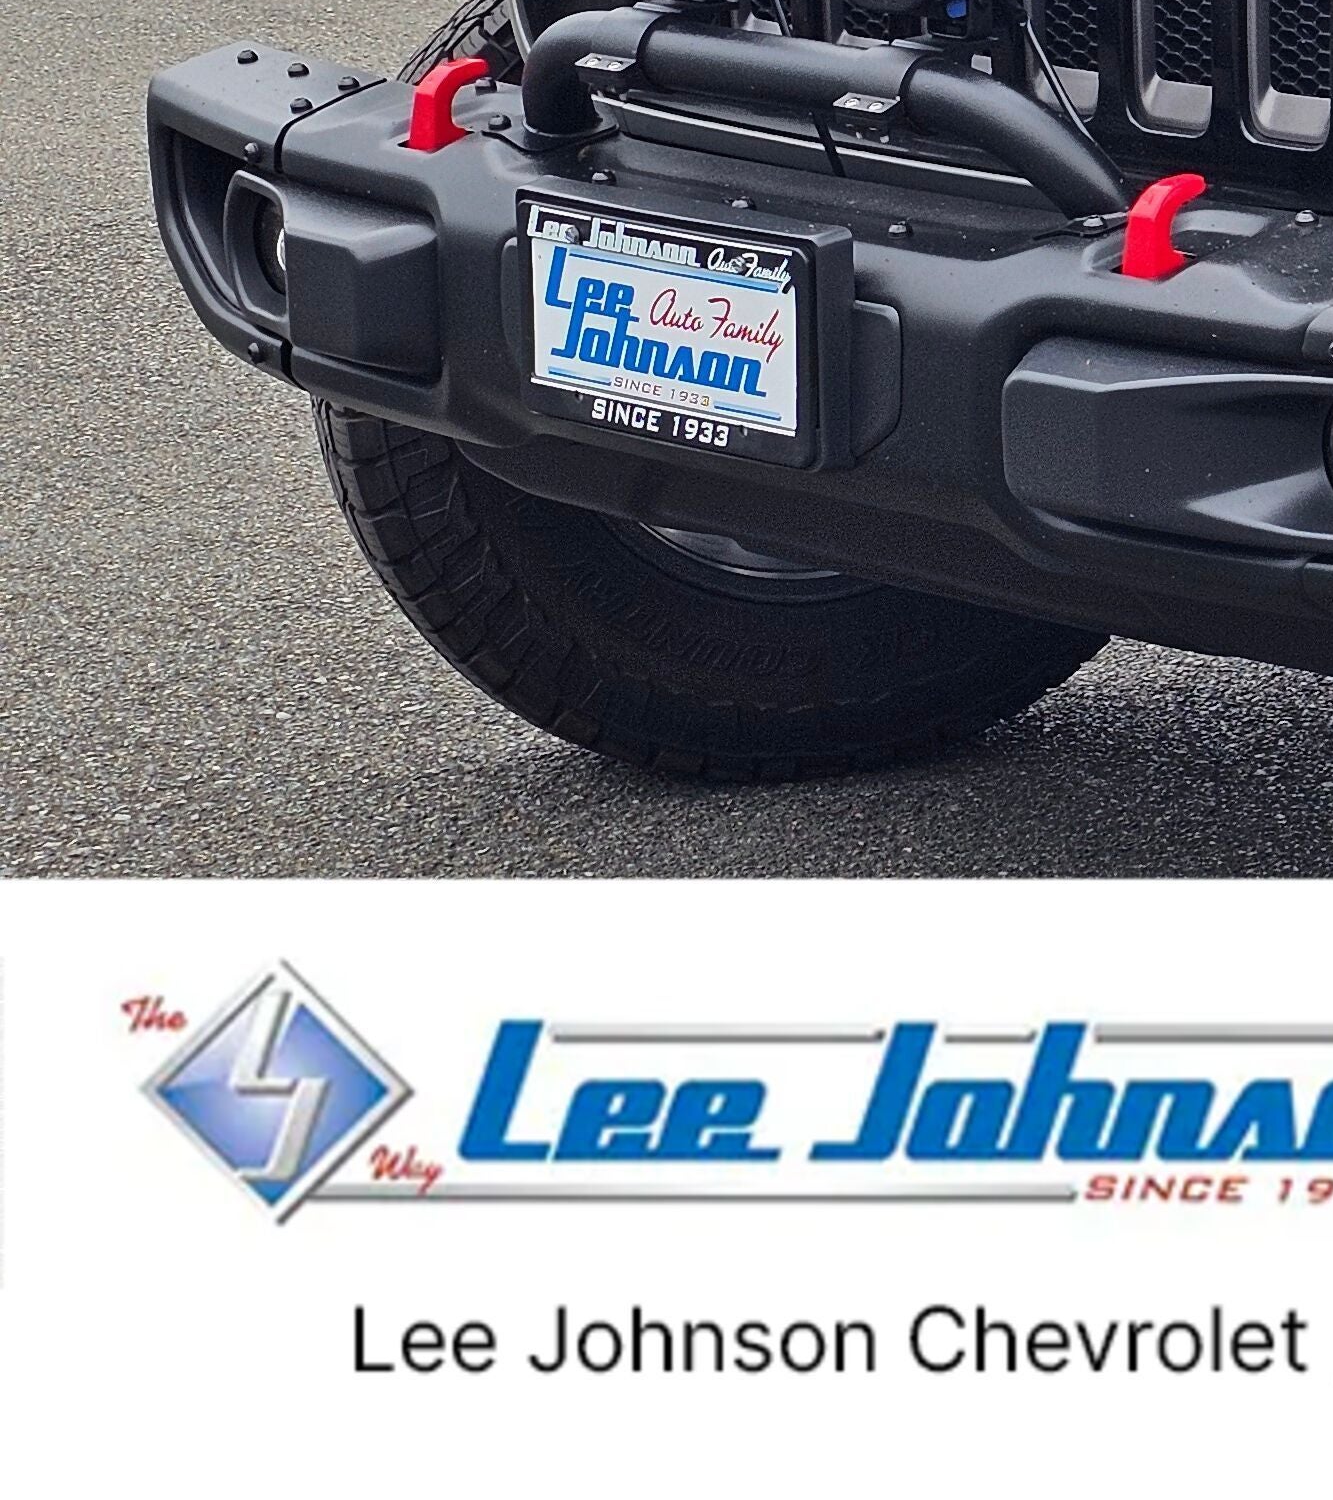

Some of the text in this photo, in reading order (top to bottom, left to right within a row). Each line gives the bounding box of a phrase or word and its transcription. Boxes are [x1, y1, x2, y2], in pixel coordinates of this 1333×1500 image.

[544, 246, 640, 323] Lee
[583, 218, 701, 268] Johnson
[742, 252, 792, 294] Family
[550, 309, 767, 398] Johnson
[649, 288, 785, 363] Auto Family
[591, 399, 730, 448] SINCE 1933
[612, 376, 663, 397] SINCE
